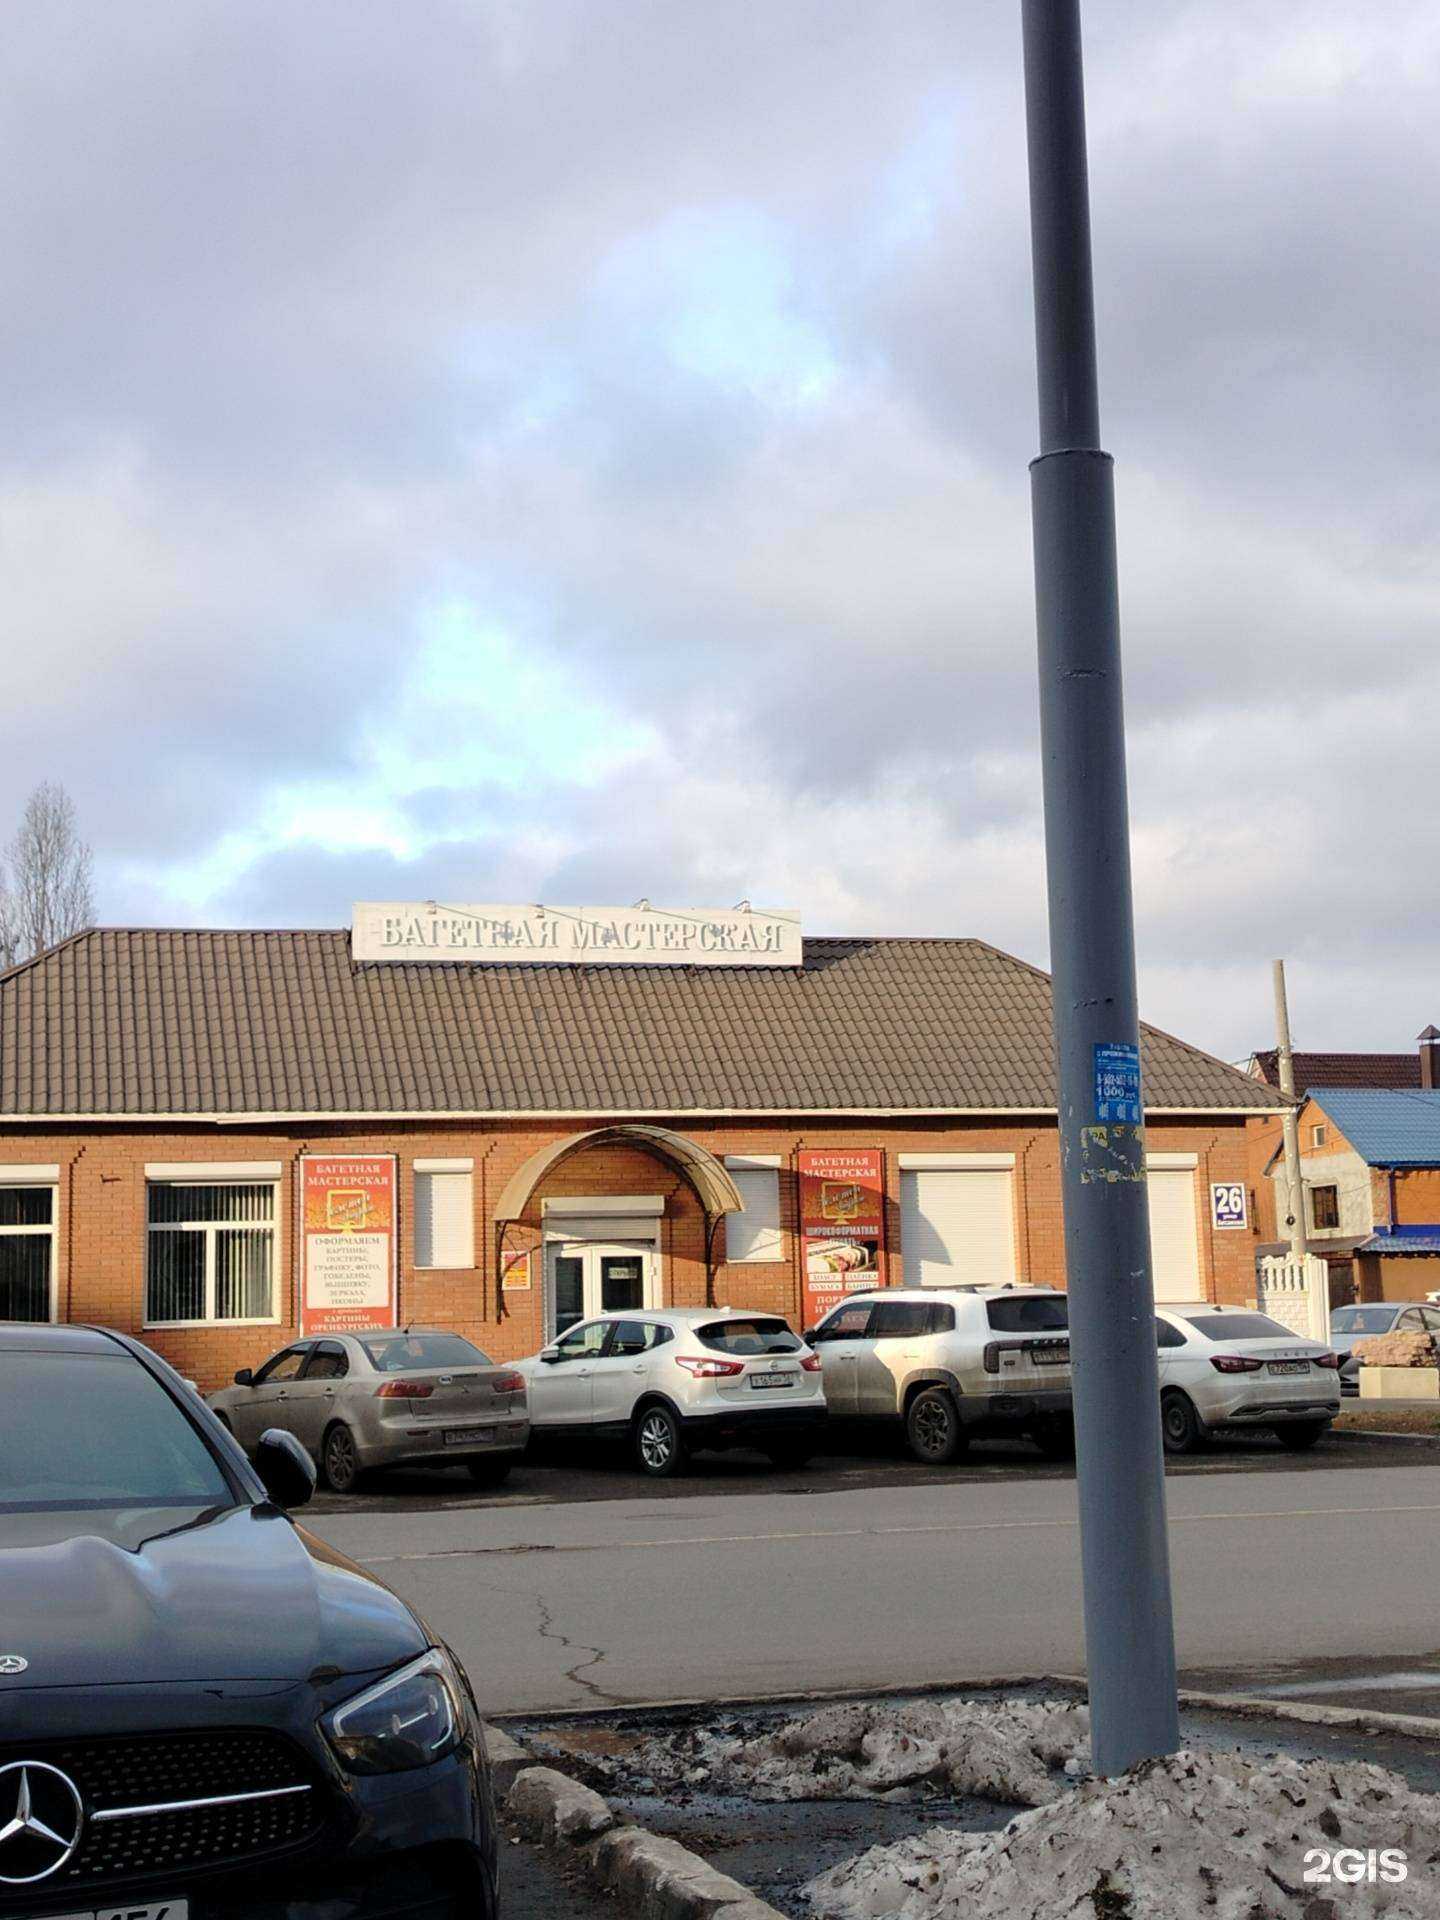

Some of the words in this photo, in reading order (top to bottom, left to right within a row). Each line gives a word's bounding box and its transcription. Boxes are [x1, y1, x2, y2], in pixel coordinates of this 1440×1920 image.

[381, 916, 558, 948] БАГЕТНАЯ
[570, 919, 784, 953] МАСТЕРСКАЯ
[811, 1157, 869, 1167] БАГЕТНАЯ
[316, 1164, 381, 1174] БАГЕТНАЯ
[804, 1168, 877, 1178] МАСТЕРСКАЯ
[308, 1175, 389, 1186] МАСТЕРСКАЯ
[1216, 1187, 1242, 1213] 26
